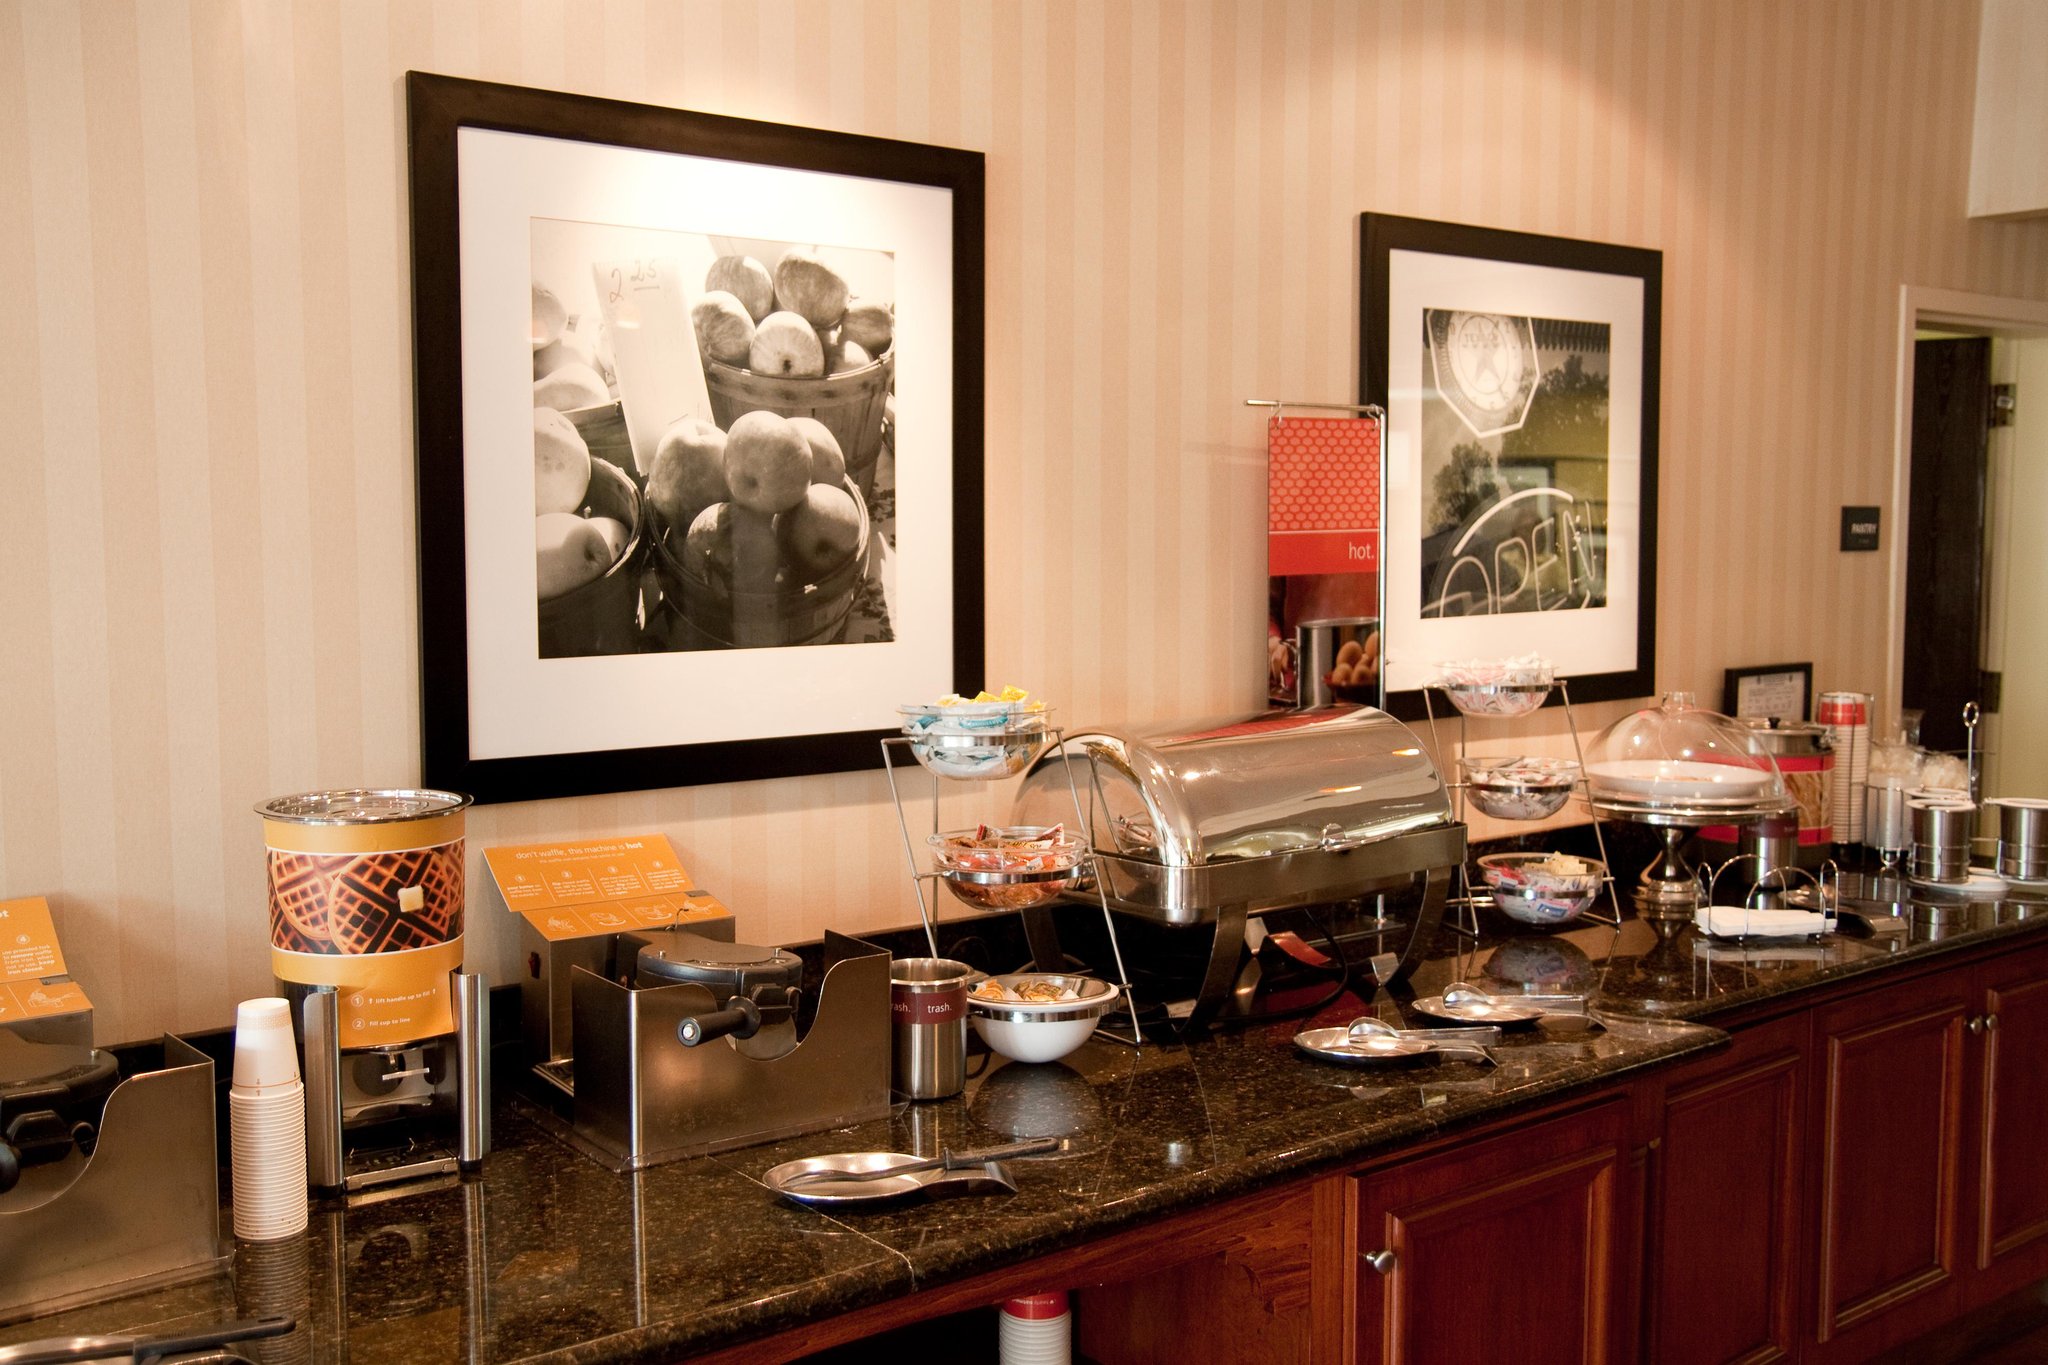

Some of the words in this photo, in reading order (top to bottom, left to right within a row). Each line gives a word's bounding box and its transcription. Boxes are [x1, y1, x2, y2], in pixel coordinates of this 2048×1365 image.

[1349, 541, 1375, 560] hot.
[515, 851, 538, 860] don't
[568, 846, 583, 855] this
[584, 844, 617, 853] machine
[625, 841, 643, 849] hot
[387, 995, 406, 1003] handle
[927, 1002, 952, 1014] trash.
